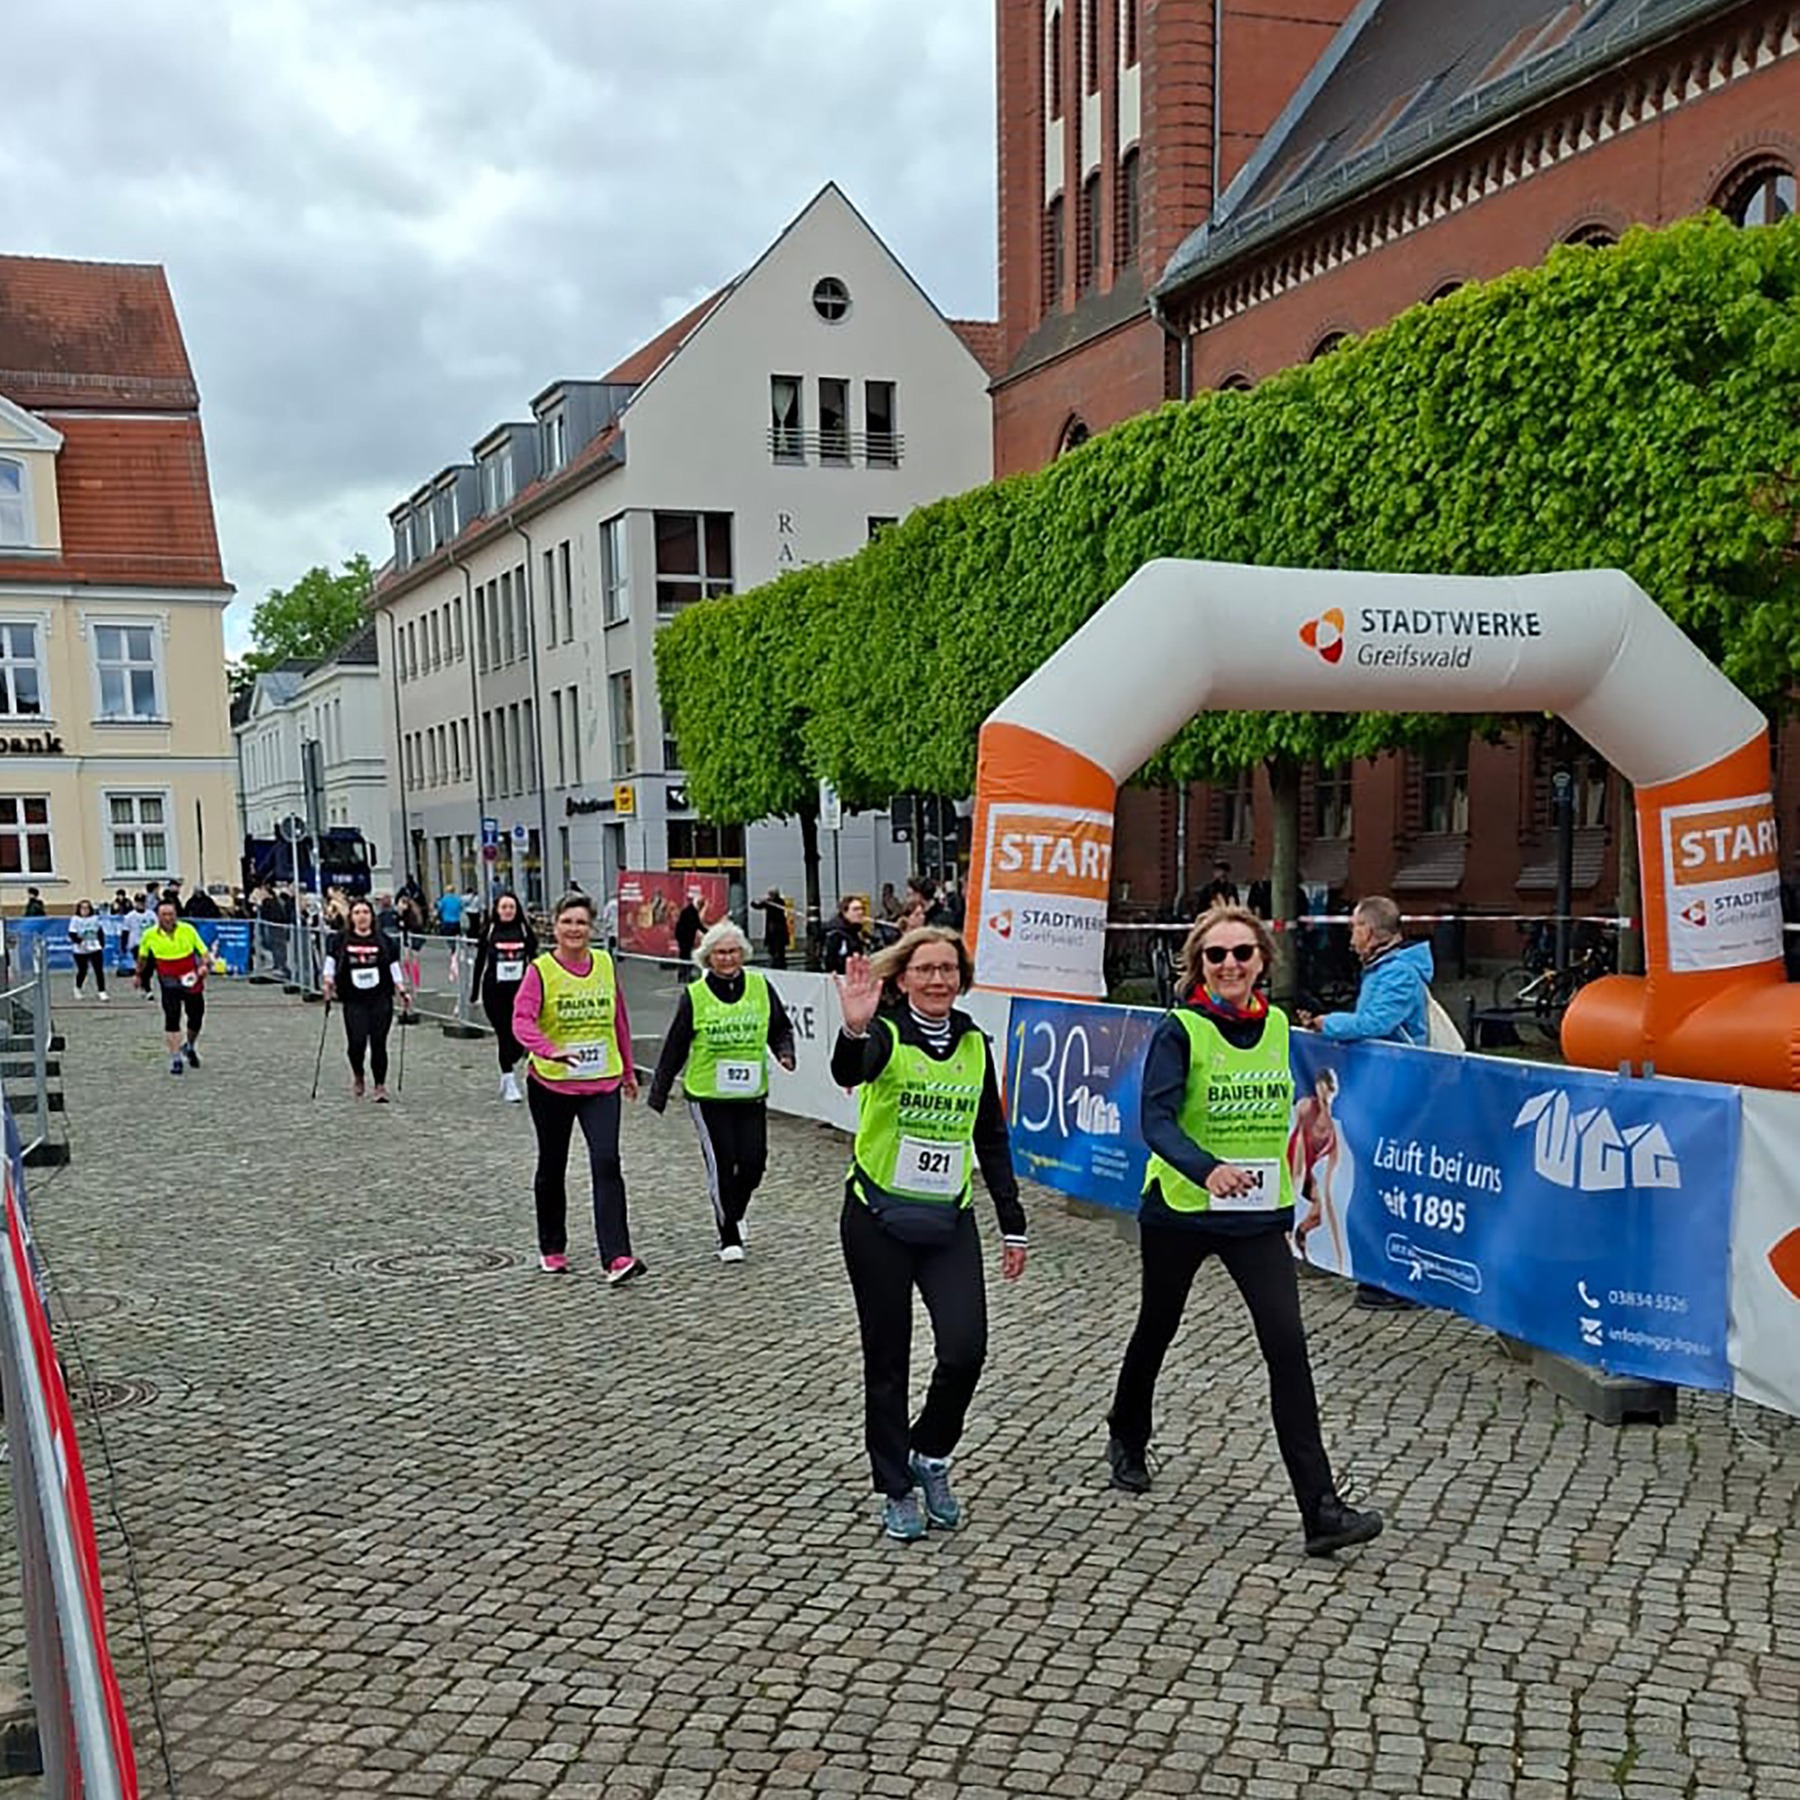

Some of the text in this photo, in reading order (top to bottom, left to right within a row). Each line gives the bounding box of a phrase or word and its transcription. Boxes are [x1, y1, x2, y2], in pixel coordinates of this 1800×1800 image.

[1361, 608, 1542, 637] STADTWERKE
[1358, 644, 1472, 668] Greifswald
[1680, 818, 1778, 868] STAR
[900, 1091, 952, 1111] BAUEN
[1208, 1083, 1288, 1101] BAUEN MV
[1513, 1088, 1682, 1192] WGG
[918, 1151, 951, 1173] 921
[1373, 1136, 1503, 1193] Läuft bei uns
[1378, 1184, 1466, 1234] eit 1895
